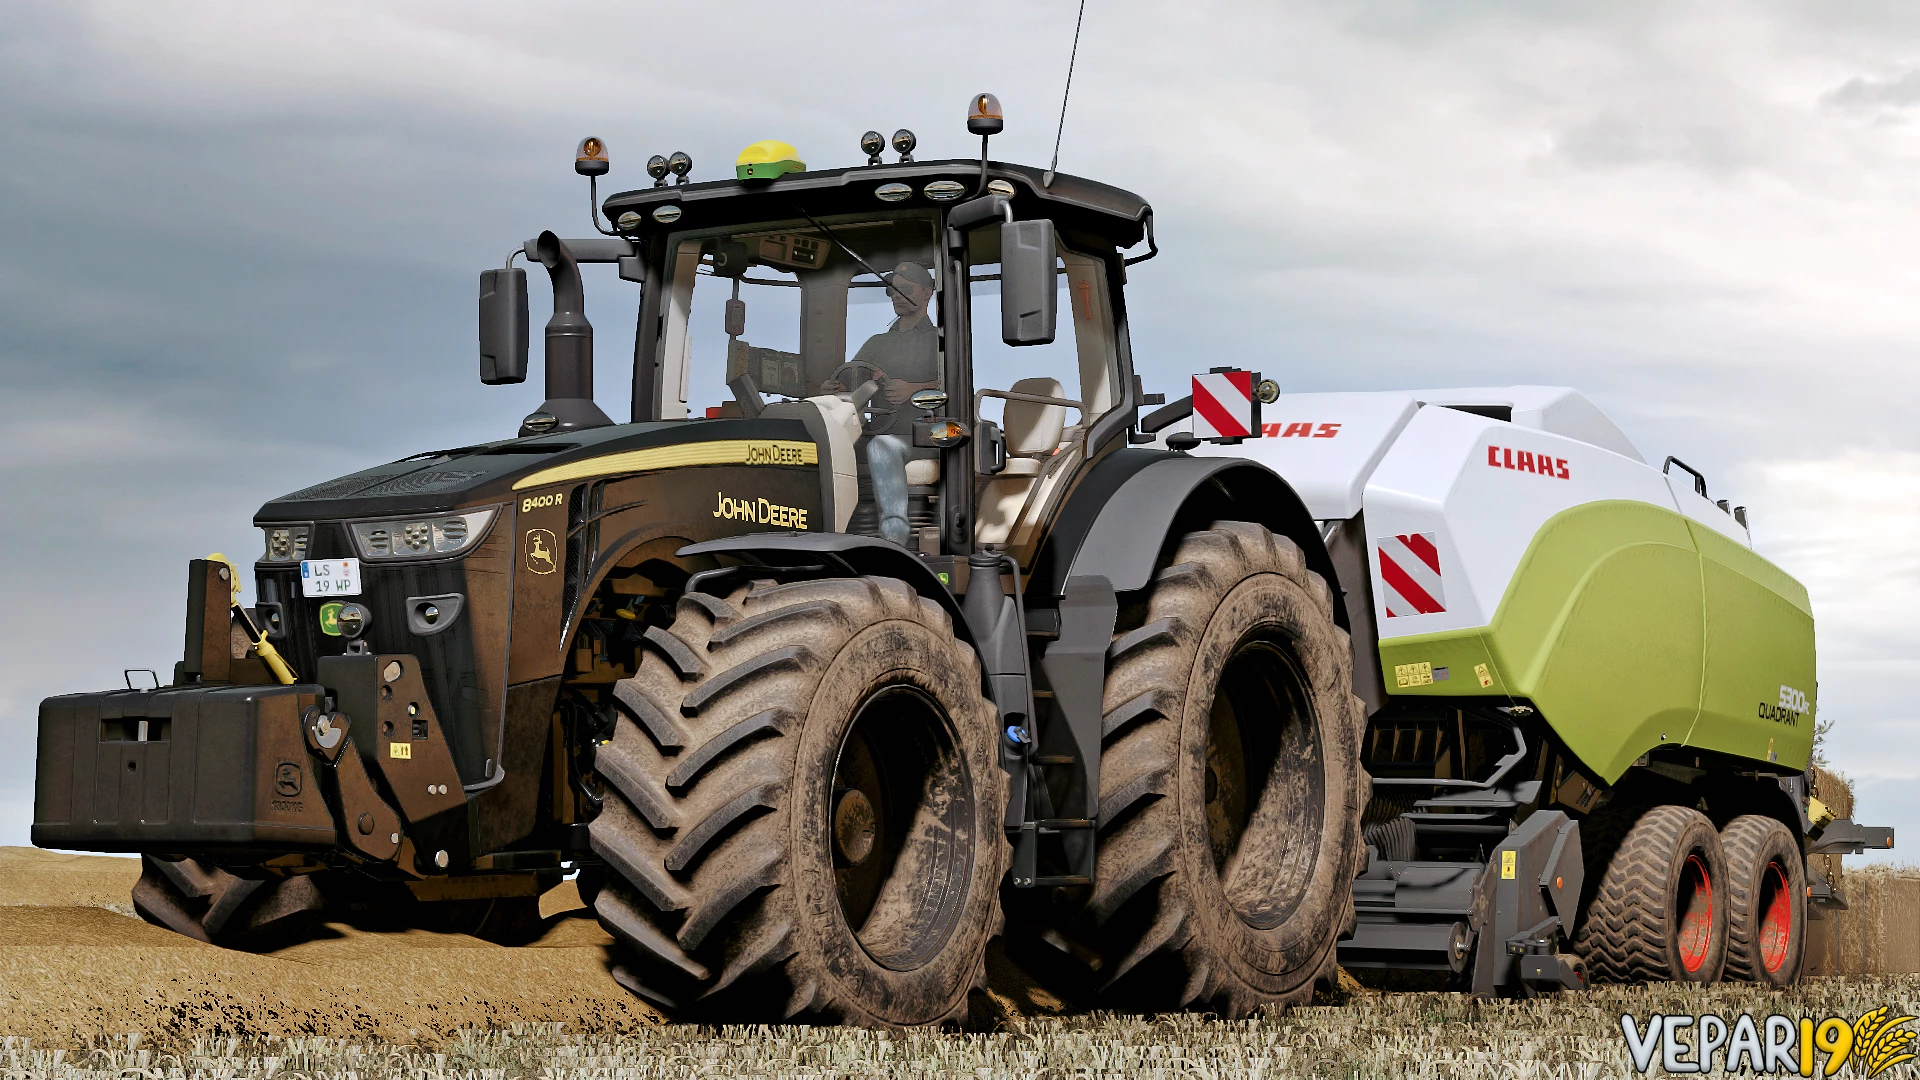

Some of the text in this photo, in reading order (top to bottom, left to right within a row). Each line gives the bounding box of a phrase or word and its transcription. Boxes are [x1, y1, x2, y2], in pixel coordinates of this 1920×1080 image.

[1261, 422, 1342, 438] AAS
[746, 444, 803, 463] JOHN DEERE
[1487, 445, 1570, 480] CLAAS
[522, 493, 563, 513] 8400 R
[712, 491, 808, 530] JOHN DEERE
[313, 564, 330, 577] LS
[316, 579, 351, 593] 19 WP
[1758, 702, 1800, 728] QUADRANT
